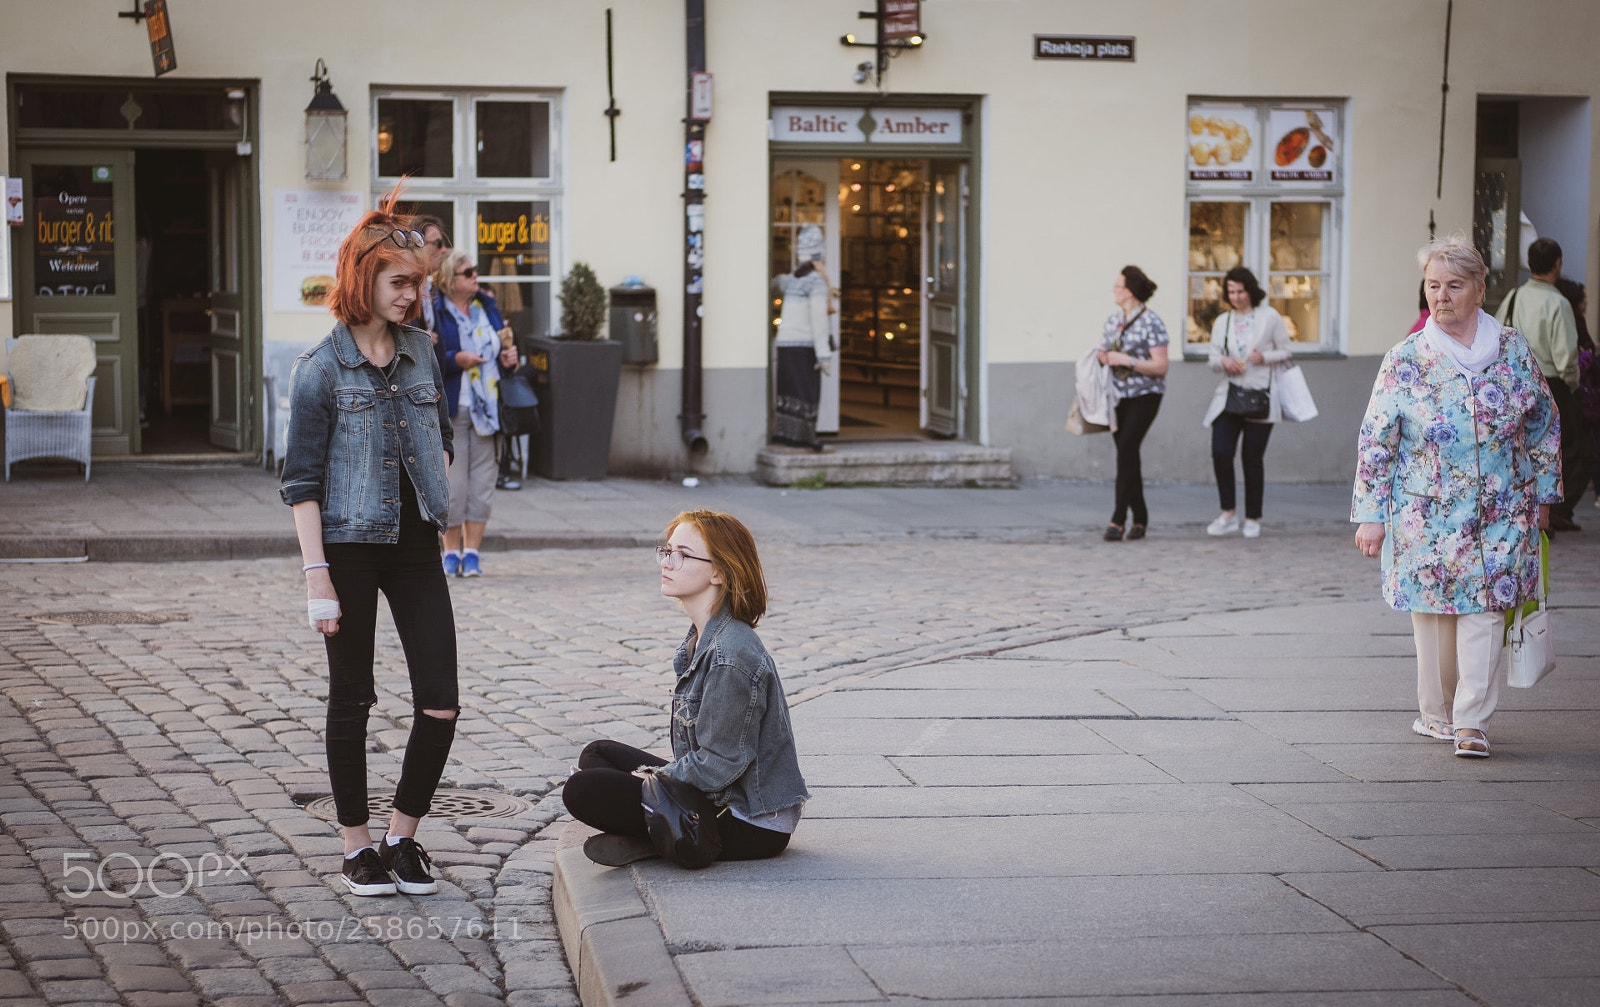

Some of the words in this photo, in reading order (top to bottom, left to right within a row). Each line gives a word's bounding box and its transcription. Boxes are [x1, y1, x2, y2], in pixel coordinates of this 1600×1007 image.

[1040, 40, 1094, 58] Raekoja
[1097, 42, 1130, 57] plats
[788, 115, 848, 133] Baltic
[879, 116, 950, 134] Amber
[58, 191, 88, 205] Open
[297, 207, 344, 221] ENJOY
[38, 210, 82, 248] burger
[84, 212, 97, 243] &
[477, 213, 517, 252] burger
[518, 214, 529, 244] &
